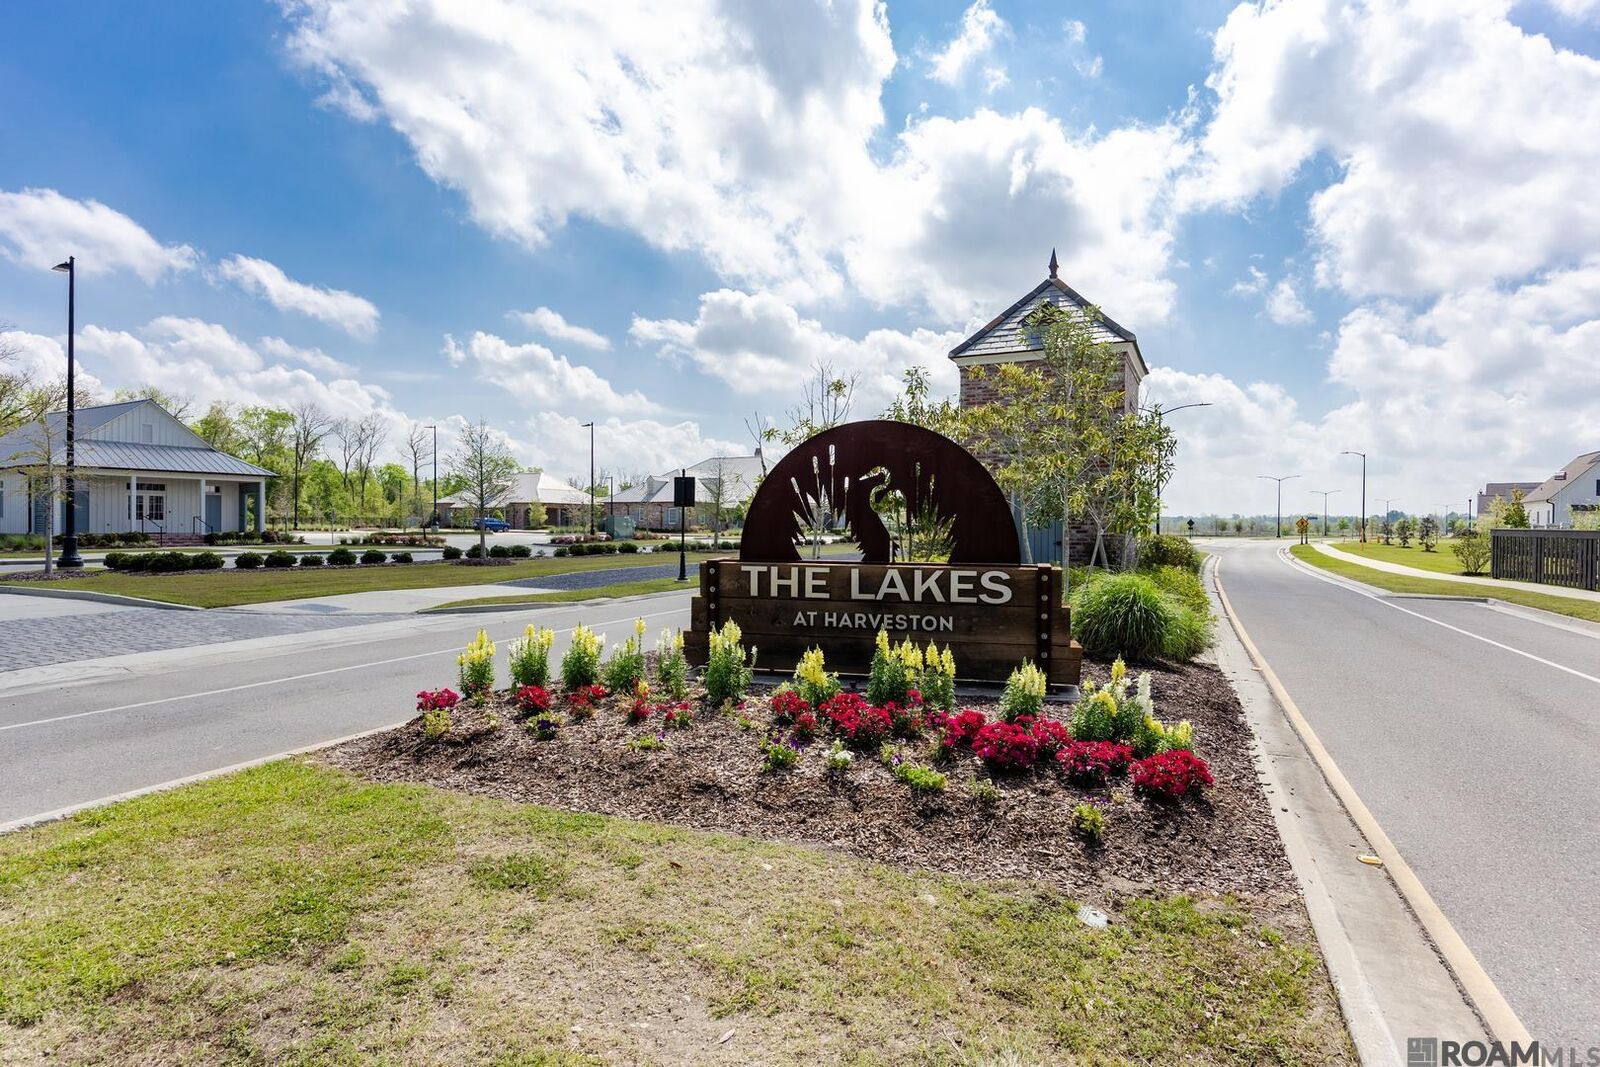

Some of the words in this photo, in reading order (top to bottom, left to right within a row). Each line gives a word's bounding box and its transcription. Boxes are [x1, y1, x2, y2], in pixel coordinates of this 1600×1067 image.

[741, 565, 830, 599] THE
[850, 567, 1013, 605] LAKES
[793, 611, 818, 627] AT
[824, 611, 954, 632] HARVESTON
